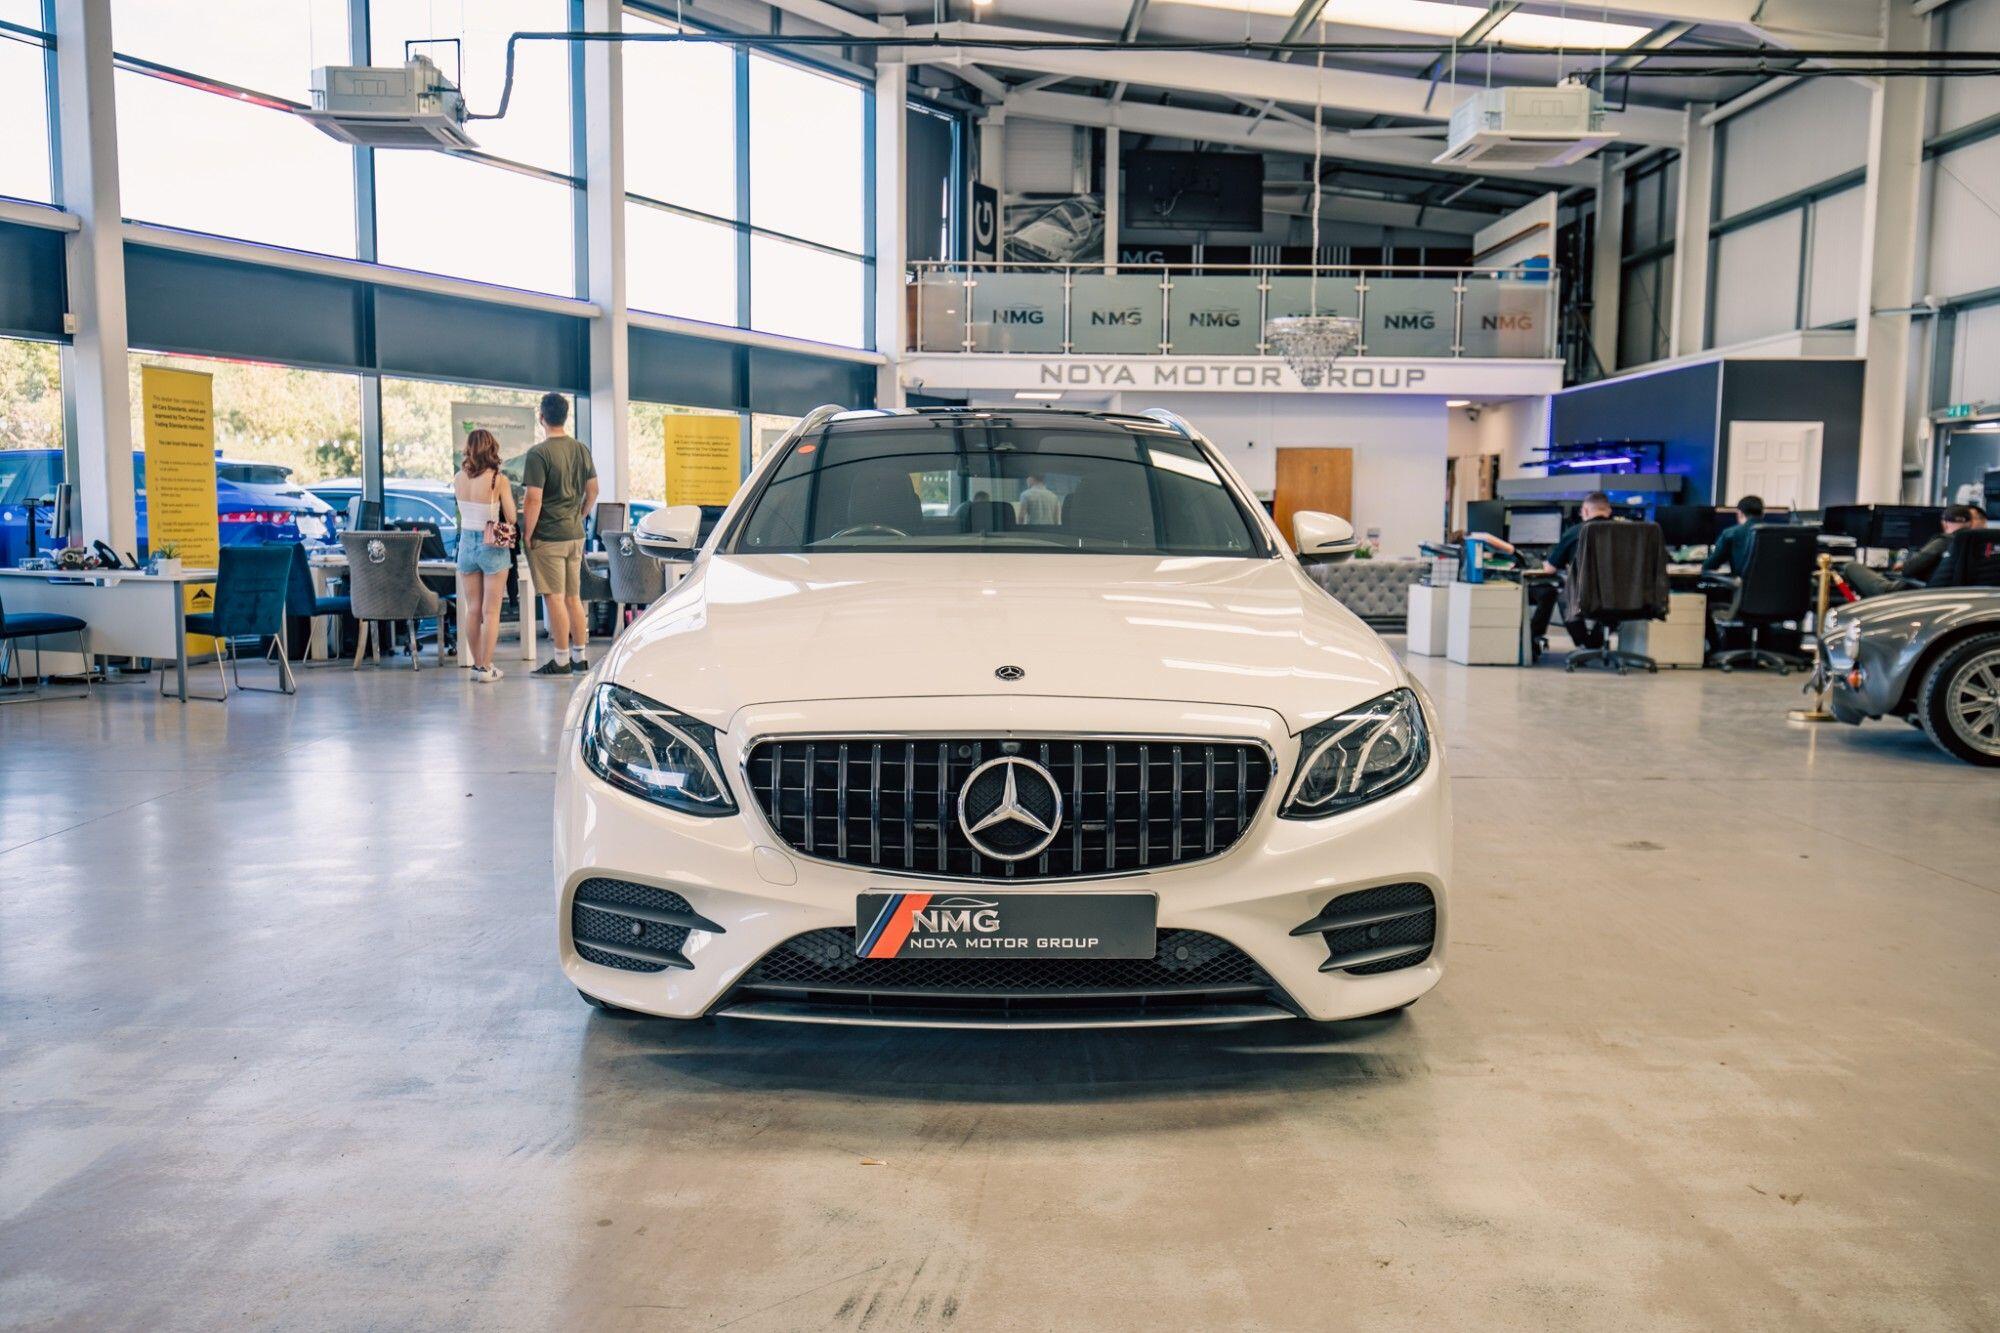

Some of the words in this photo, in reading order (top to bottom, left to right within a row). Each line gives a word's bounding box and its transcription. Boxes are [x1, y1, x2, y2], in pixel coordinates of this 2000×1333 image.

[993, 310, 1044, 324] NMG
[1091, 311, 1143, 326] NMG
[1189, 312, 1240, 328] NMG
[1384, 314, 1436, 330] NMG
[1481, 315, 1533, 330] NMG
[1040, 363, 1136, 385] NOYA
[1154, 365, 1282, 386] MOTOR
[912, 909, 1000, 933] NMG
[910, 938, 957, 949] NOYA
[965, 938, 1028, 948] MOTOR
[1036, 938, 1099, 948] GROUP
